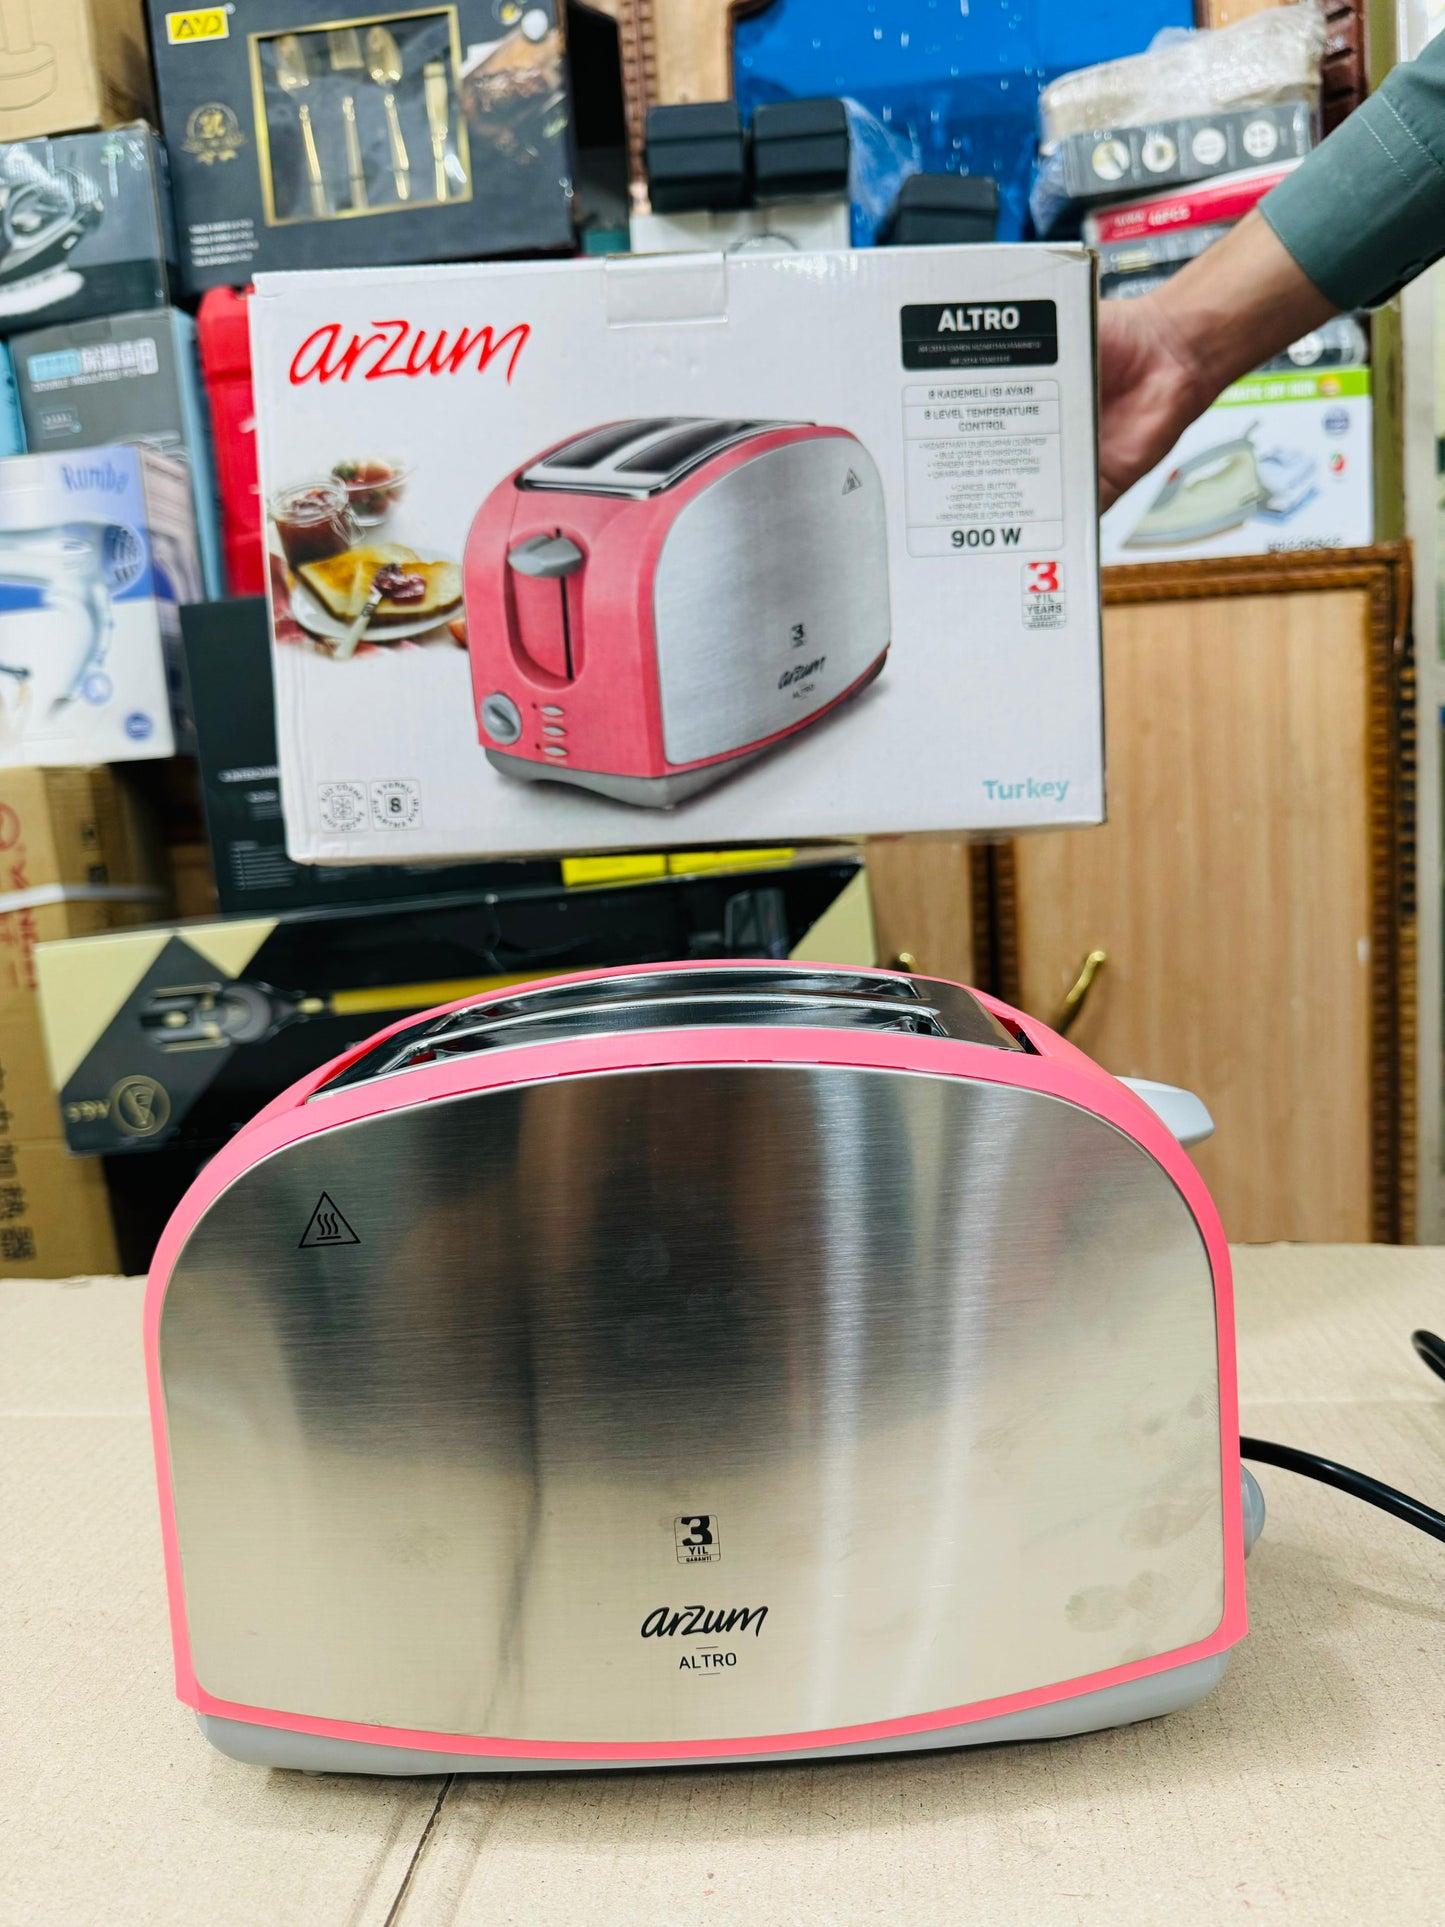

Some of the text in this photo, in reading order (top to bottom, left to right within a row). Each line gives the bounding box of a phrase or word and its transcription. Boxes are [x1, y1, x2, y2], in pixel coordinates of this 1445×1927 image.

[937, 306, 1020, 332] ALTRO
[289, 320, 530, 386] arzum
[933, 408, 964, 420] LEVEL
[966, 406, 1039, 418] TEMPERATURE
[958, 421, 1006, 432] CONTROL
[951, 527, 1021, 548] 900 W
[1028, 561, 1059, 593] 3
[1034, 593, 1055, 603] YIL
[1027, 604, 1062, 615] YEARS
[792, 623, 804, 640] 3
[982, 777, 1070, 802] Turkey
[391, 797, 402, 812] 8
[681, 1516, 712, 1546] 3
[688, 1546, 709, 1555] YIL
[641, 1605, 769, 1638] arzum
[679, 1652, 737, 1670] ALTRO
